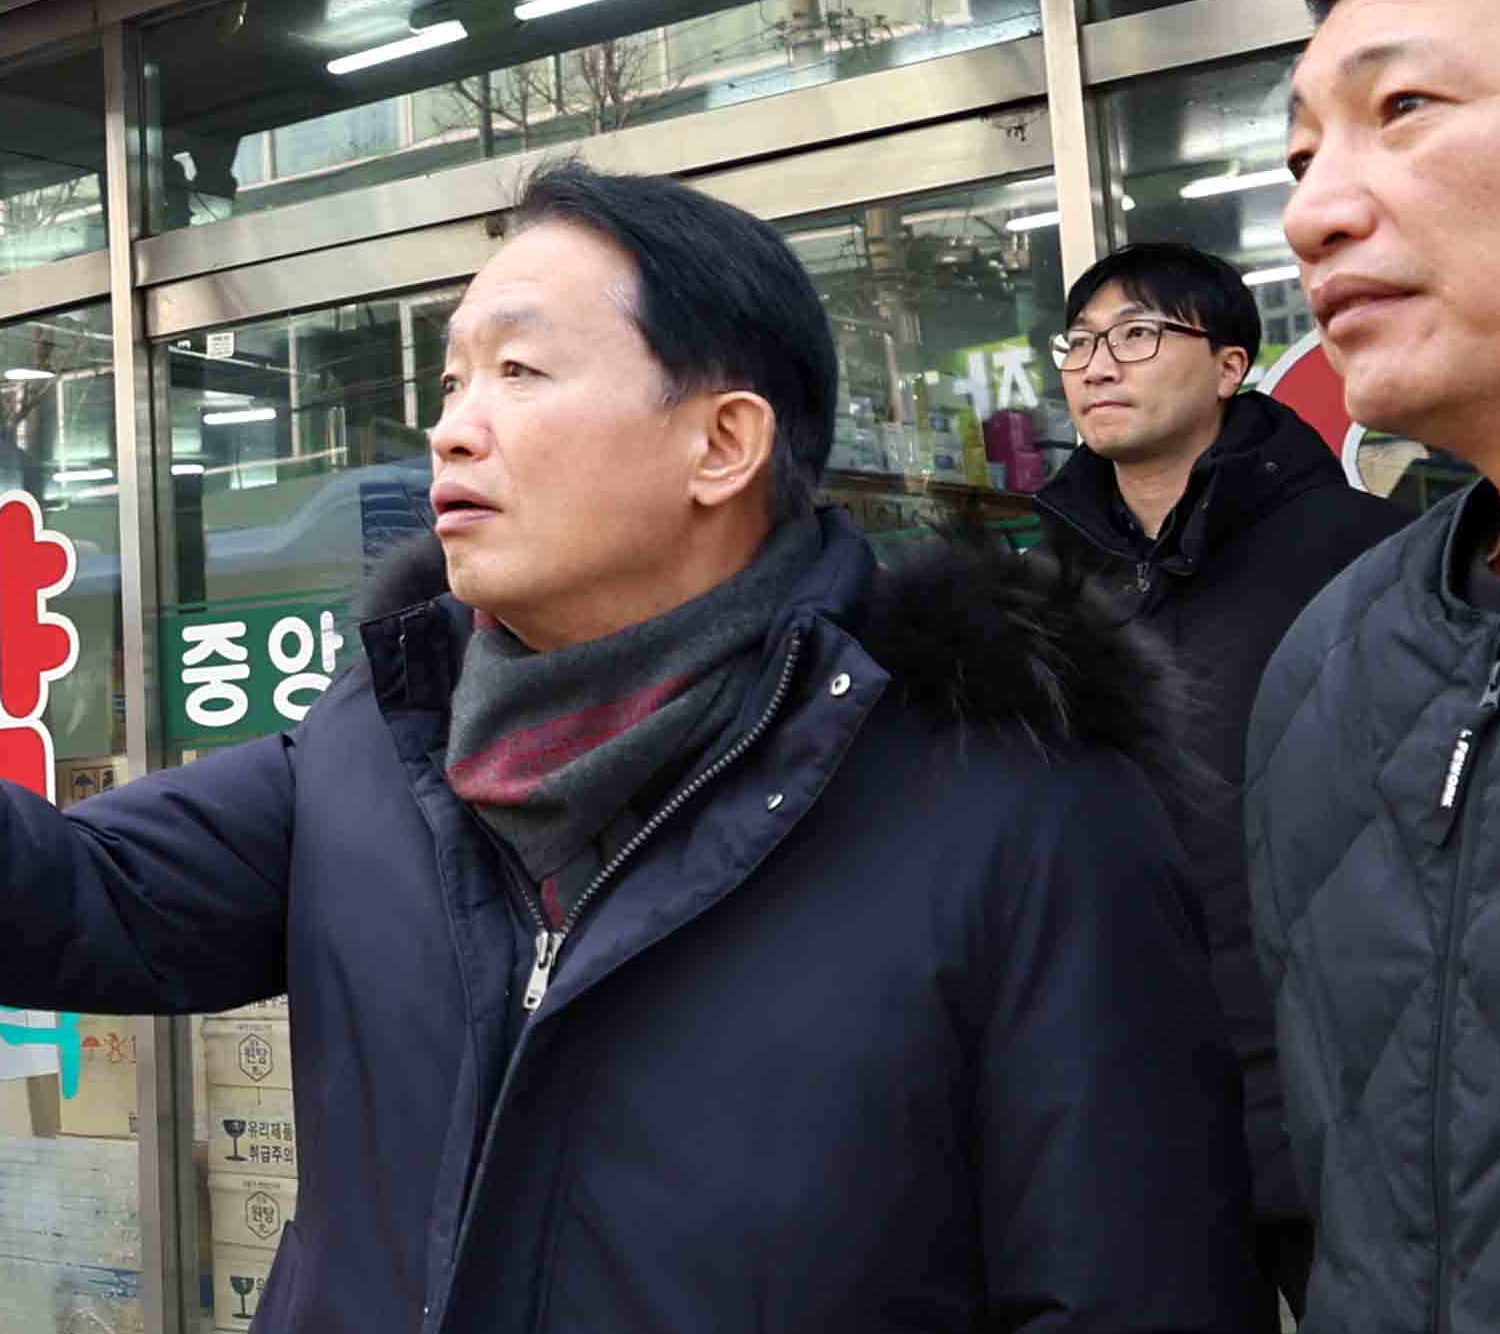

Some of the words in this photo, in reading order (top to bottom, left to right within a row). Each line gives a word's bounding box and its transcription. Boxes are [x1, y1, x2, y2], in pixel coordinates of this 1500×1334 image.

[182, 610, 343, 727] 중앙
[247, 1121, 294, 1142] 유리제품
[249, 1144, 294, 1164] 취급주의
